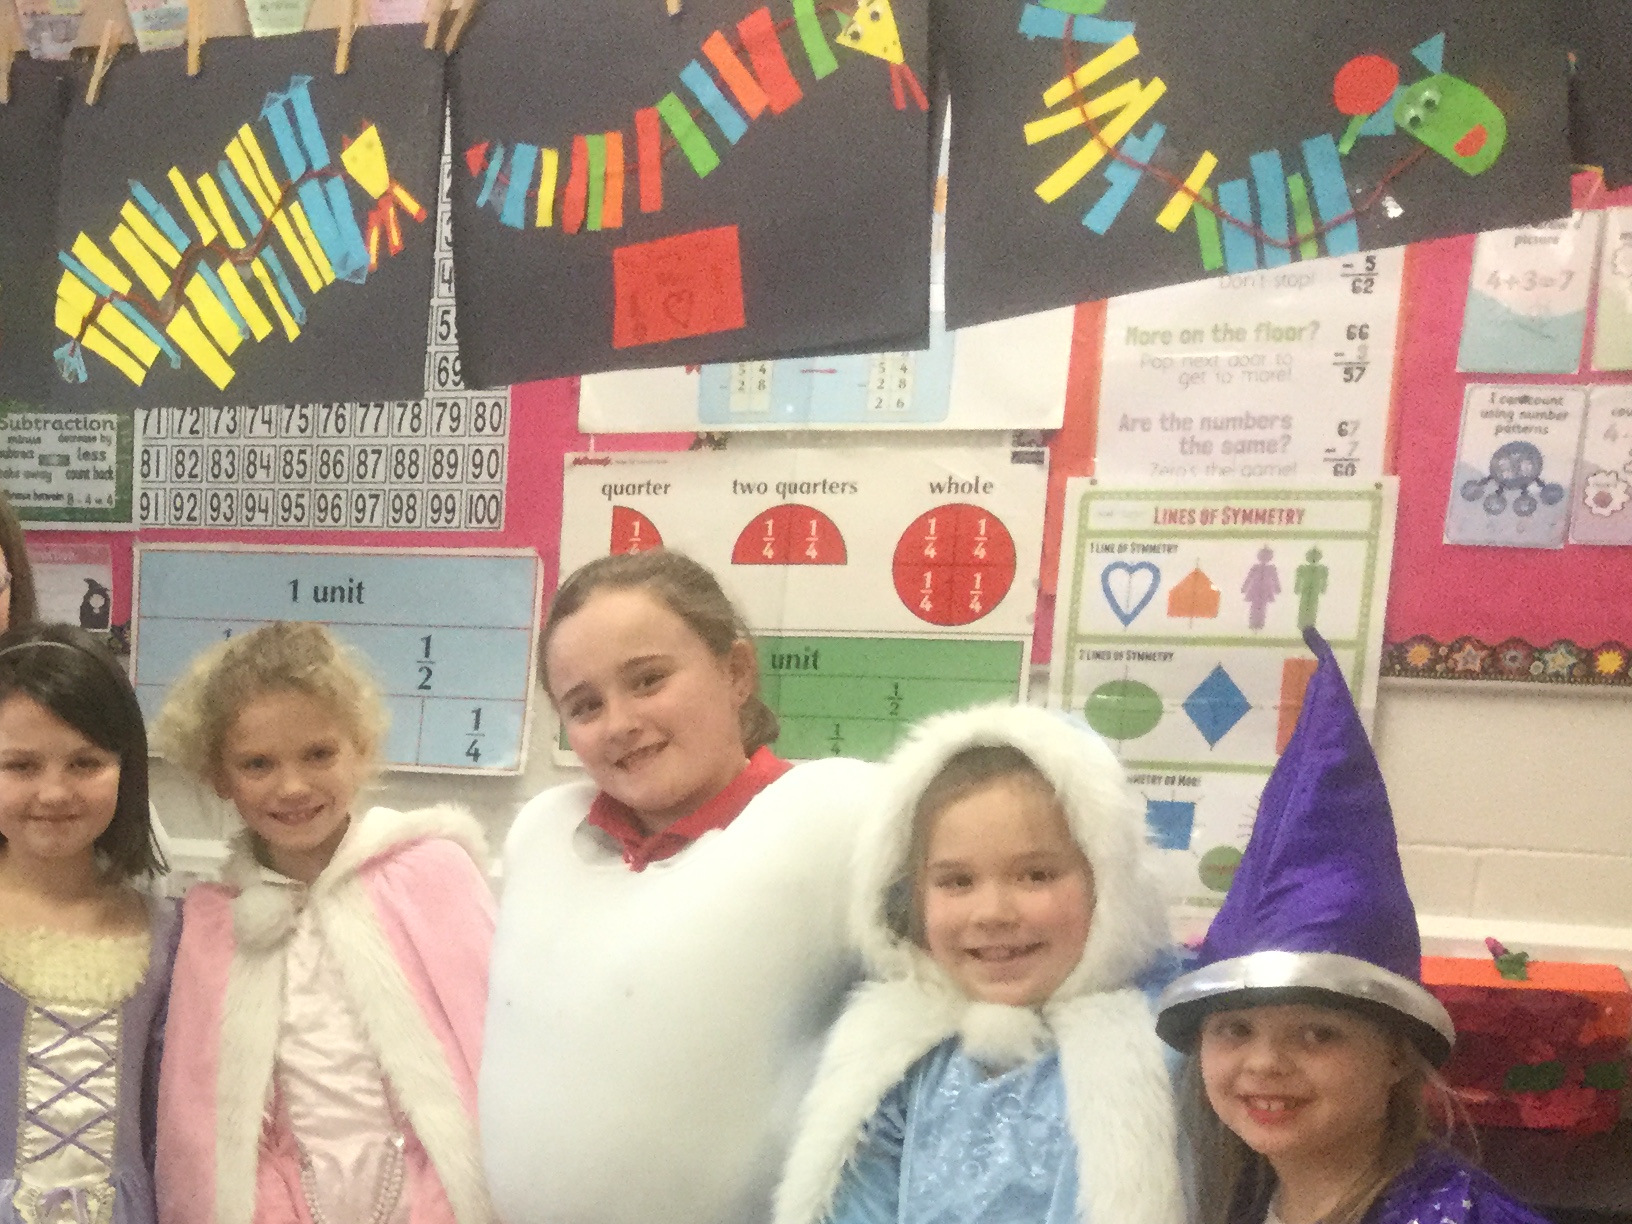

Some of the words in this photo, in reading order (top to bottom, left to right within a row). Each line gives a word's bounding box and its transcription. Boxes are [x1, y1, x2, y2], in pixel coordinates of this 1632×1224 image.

[1365, 255, 1377, 272] 5
[1351, 278, 1374, 295] 62
[1125, 325, 1172, 346] More
[1179, 327, 1205, 344] on
[1211, 323, 1247, 342] the
[1254, 320, 1320, 343] floor?
[1346, 324, 1370, 341] 66
[1343, 367, 1366, 383] 57
[322, 403, 346, 434] 76
[358, 403, 385, 433] 77
[396, 402, 422, 433] 78
[435, 402, 461, 433] 79
[474, 401, 503, 433] 80
[1118, 413, 1152, 432] Are
[1159, 412, 1193, 431] the
[1199, 411, 1293, 431] numbers
[1337, 420, 1361, 438] 67
[77, 447, 107, 461] less
[1179, 435, 1213, 456] the
[1221, 434, 1292, 456] same?
[141, 449, 160, 479] 81
[174, 449, 199, 479] 82
[210, 449, 236, 479] 83
[246, 449, 271, 479] 84
[282, 449, 308, 479] 85
[319, 449, 345, 479] 86
[356, 449, 382, 479] 87
[394, 449, 419, 479] 88
[432, 449, 459, 479] 89
[471, 449, 500, 479] 90
[601, 479, 671, 501] quarter
[732, 479, 768, 495] two
[775, 478, 858, 500] quarters
[929, 476, 994, 495] whole
[139, 493, 159, 523] 91
[173, 493, 198, 523] 92
[209, 493, 234, 523] 93
[245, 493, 269, 523] 94
[280, 493, 306, 523] 95
[317, 493, 342, 523] 96
[354, 493, 380, 523] 97
[391, 493, 417, 523] 98
[430, 493, 457, 523] 99
[468, 493, 499, 523] 100
[1153, 507, 1197, 525] LINES
[1199, 508, 1219, 525] OF
[1221, 506, 1306, 526] SYMMETRY
[288, 579, 300, 603] 1
[313, 577, 365, 604] unit
[771, 646, 819, 670] unit
